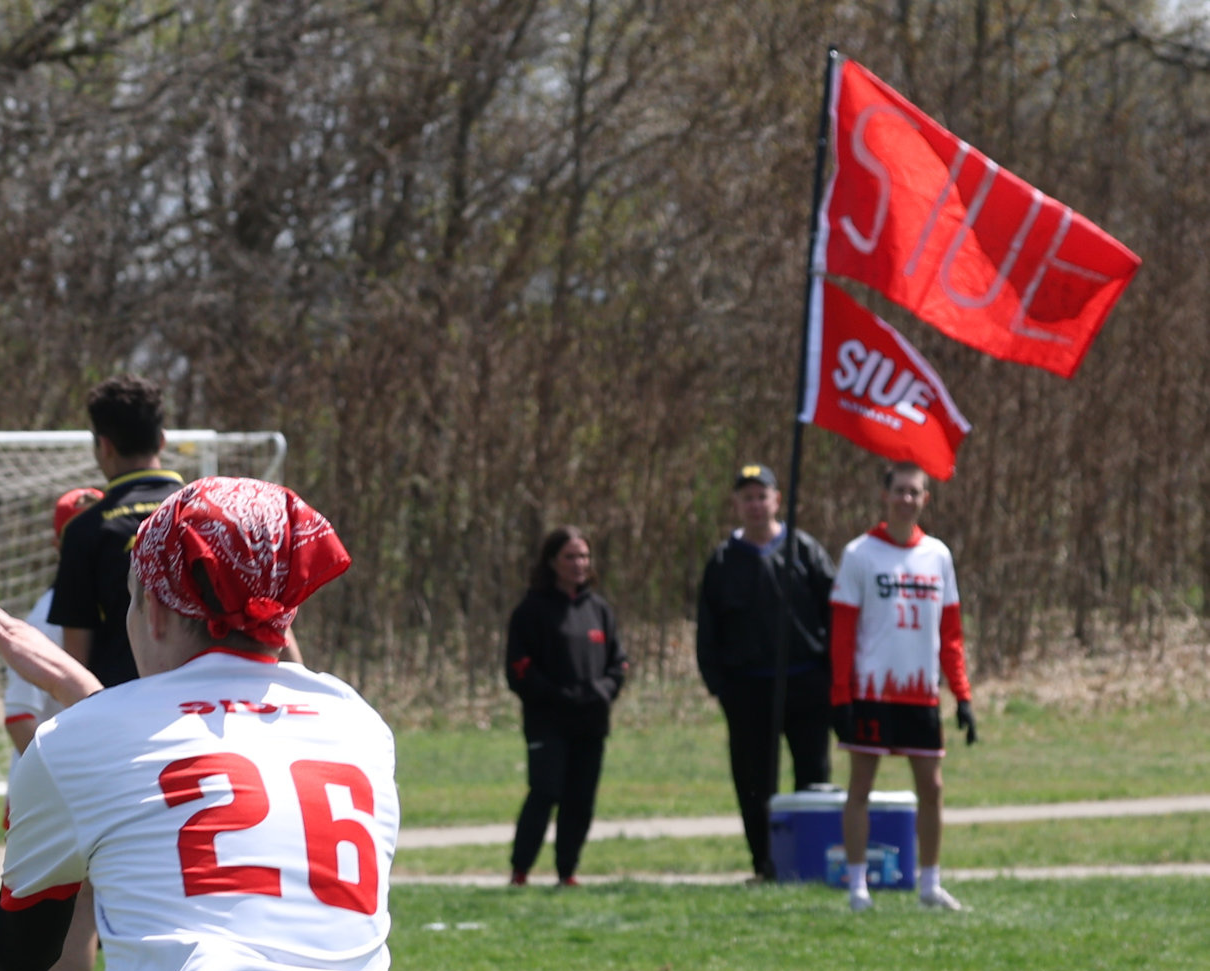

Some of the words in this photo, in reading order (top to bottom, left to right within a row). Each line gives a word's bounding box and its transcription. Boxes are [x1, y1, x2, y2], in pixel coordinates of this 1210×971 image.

[840, 103, 1111, 345] SIUE
[832, 338, 937, 425] SIUE
[895, 603, 922, 630] 11
[158, 752, 379, 916] 26
